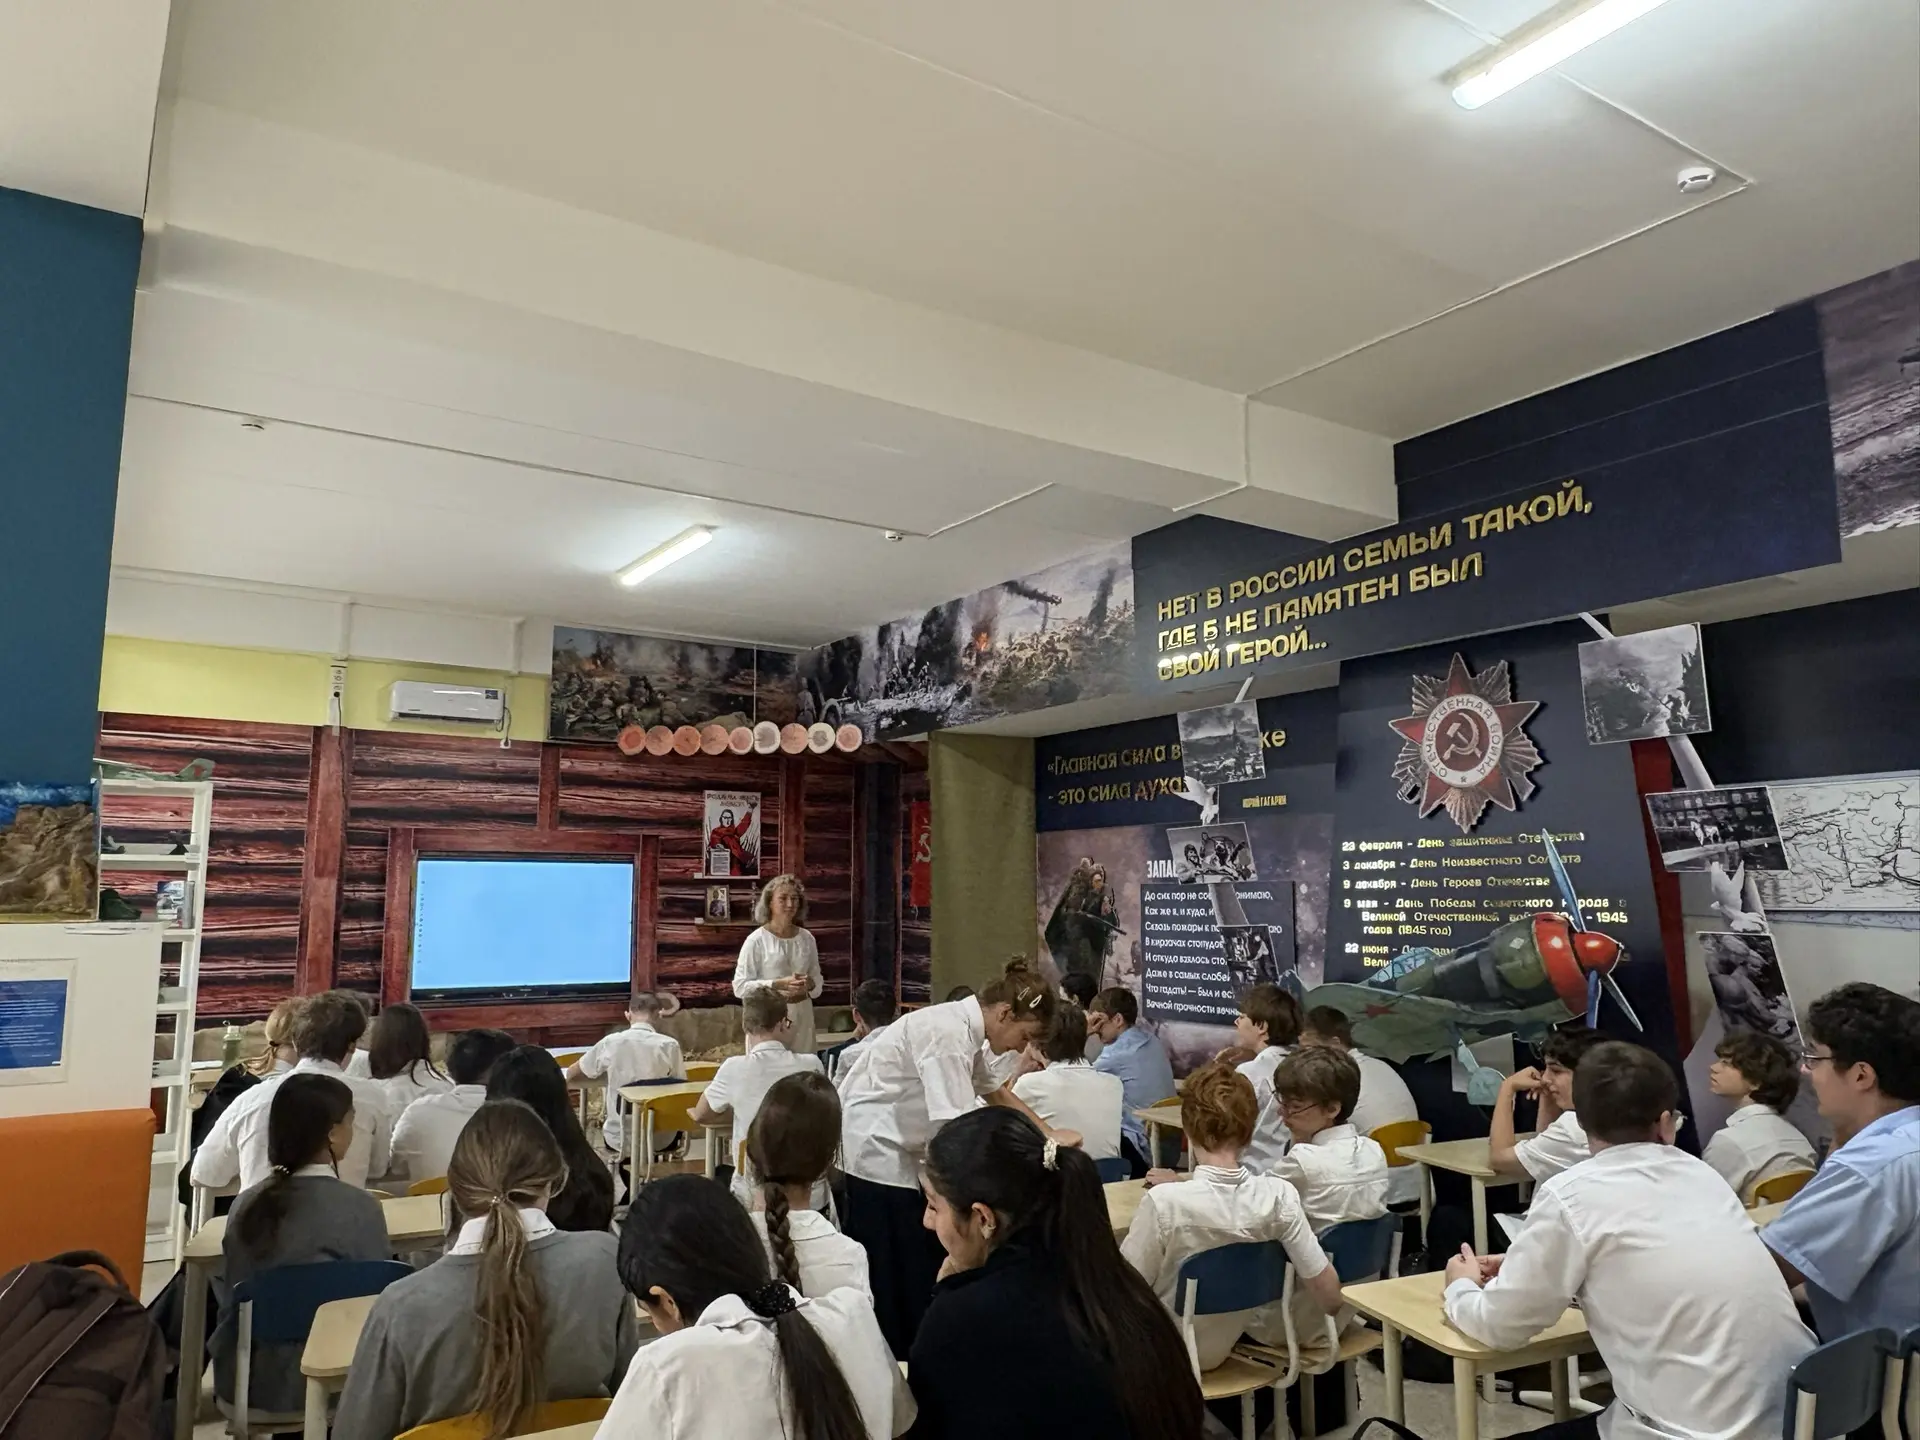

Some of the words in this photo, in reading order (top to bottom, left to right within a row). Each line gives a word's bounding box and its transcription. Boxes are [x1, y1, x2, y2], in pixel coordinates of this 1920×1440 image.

[1158, 592, 1200, 621] НЕТ
[1206, 586, 1223, 610] В
[1229, 555, 1335, 604] РОССИИ
[1343, 522, 1452, 572] СЕМЬИ
[1462, 479, 1593, 540] ТАКОЙ,
[1158, 624, 1197, 652] ГДЕ
[1203, 618, 1219, 642] Б
[1225, 608, 1258, 637] НЕ
[1264, 574, 1399, 627] ПАМЯТЕН
[1409, 552, 1483, 592] БЫЛ
[1157, 643, 1220, 681] СВОЙ
[1225, 625, 1328, 668] ГЕРОЙ...
[1171, 744, 1181, 760] в
[1058, 787, 1086, 805] это
[1088, 782, 1131, 803] сила
[1359, 841, 1403, 852] февраля
[1417, 838, 1445, 848] День
[1518, 832, 1585, 844] Отеества
[1342, 861, 1350, 870] 3
[1354, 859, 1396, 871] декабря
[1409, 858, 1437, 868] День
[1442, 856, 1522, 867] Неизвестного
[1343, 880, 1351, 889] 9
[1354, 879, 1397, 890] декабря
[1410, 878, 1438, 889] День
[1443, 878, 1482, 889] Героев
[1145, 890, 1155, 901] До
[1171, 892, 1186, 902] пор
[1187, 892, 1197, 900] не
[1235, 890, 1273, 901] онимаю,
[1343, 899, 1351, 909] 9
[1356, 899, 1378, 908] мая
[1395, 898, 1424, 909] День
[1430, 898, 1476, 909] Победы
[1145, 906, 1158, 915] Как
[1160, 907, 1172, 915] же
[1180, 907, 1186, 915] и
[1186, 907, 1208, 918] худа,
[1361, 911, 1407, 922] Великой
[1414, 911, 1500, 922] Отечественной
[1597, 912, 1628, 923] 1945
[1145, 921, 1170, 931] Сквозь
[1172, 923, 1204, 934] пожары
[1205, 923, 1210, 932] к
[1363, 925, 1393, 935] годов
[1430, 925, 1452, 936] год)
[1145, 937, 1150, 946] В
[1344, 942, 1359, 953] 22
[1362, 945, 1389, 954] июня
[1145, 952, 1152, 961] И
[1153, 953, 1178, 963] откуда
[1145, 968, 1168, 978] Даже
[1174, 970, 1200, 980] самых
[1146, 983, 1159, 993] Что
[1160, 985, 1187, 996] гадать!
[1214, 989, 1220, 998] и
[1146, 999, 1173, 1010] Вечной
[1174, 1002, 1215, 1014] прочности
